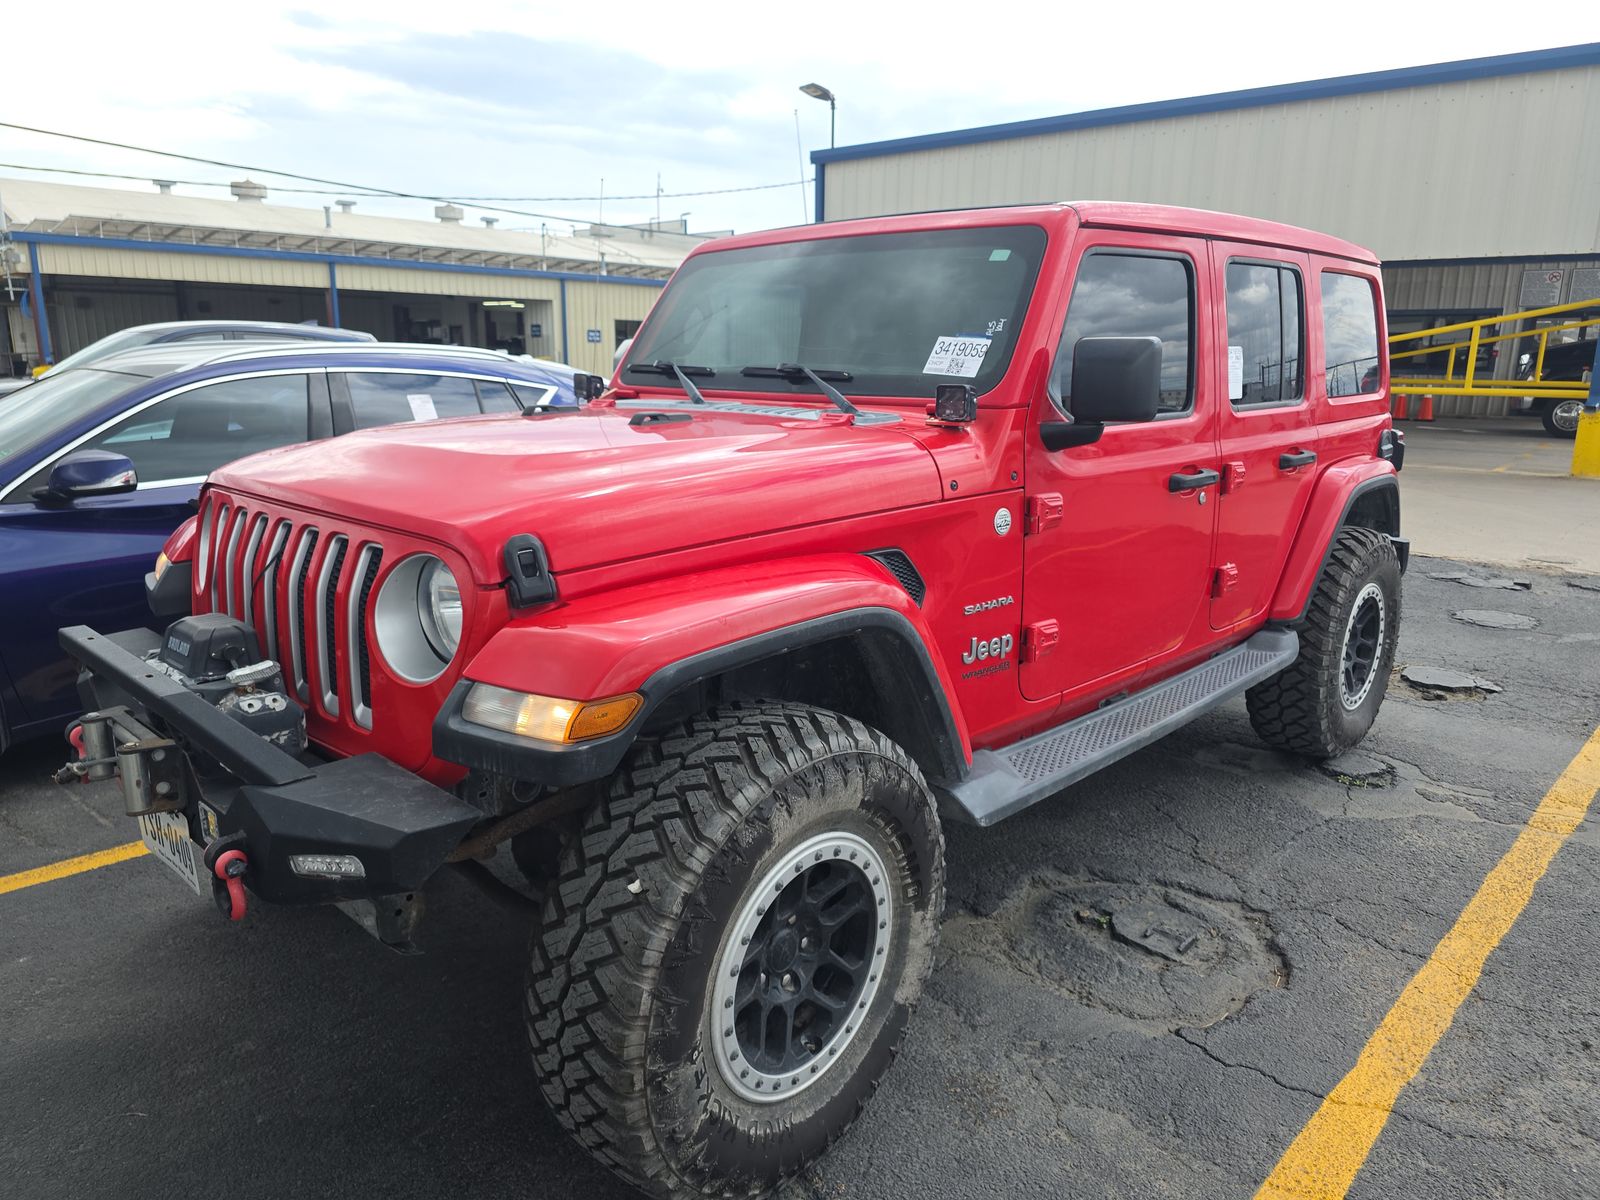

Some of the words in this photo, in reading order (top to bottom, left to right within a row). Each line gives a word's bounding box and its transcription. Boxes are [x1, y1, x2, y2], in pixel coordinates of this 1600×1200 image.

[935, 341, 988, 358] 3419059
[964, 595, 1014, 614] SAHARA
[962, 633, 1013, 664] Jeep
